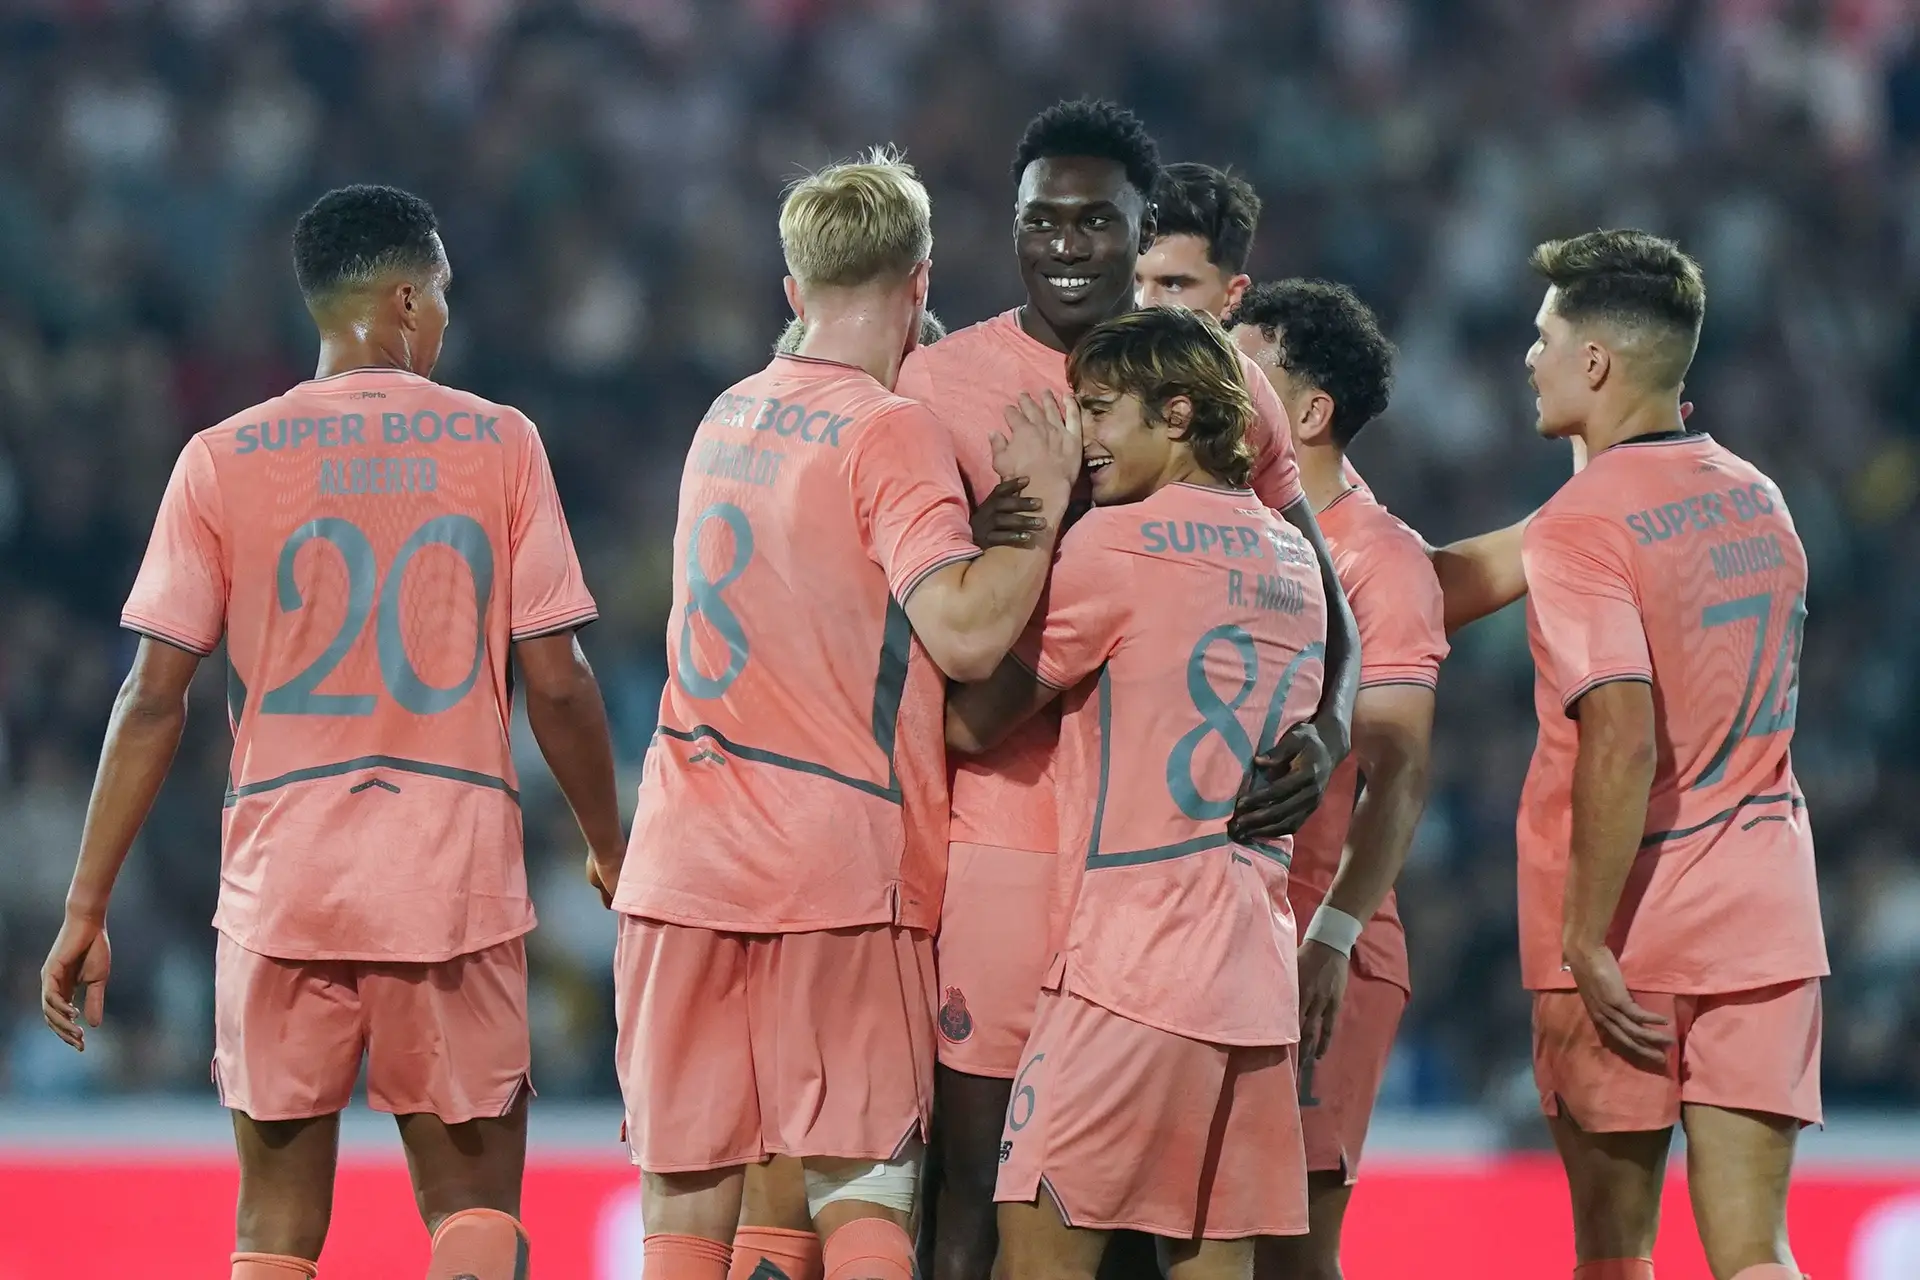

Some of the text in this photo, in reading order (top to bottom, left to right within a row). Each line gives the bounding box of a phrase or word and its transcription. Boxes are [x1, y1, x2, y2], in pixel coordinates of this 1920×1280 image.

[235, 410, 501, 455] SUPER BOCK
[752, 398, 854, 447] BOCK
[319, 457, 438, 496] ALBERTO
[1140, 521, 1265, 559] SUPER
[1626, 492, 1727, 547] SUPER
[1709, 533, 1787, 581] MOURA
[259, 514, 495, 717] 20
[677, 502, 755, 700] 8
[1009, 1053, 1046, 1132] 6
